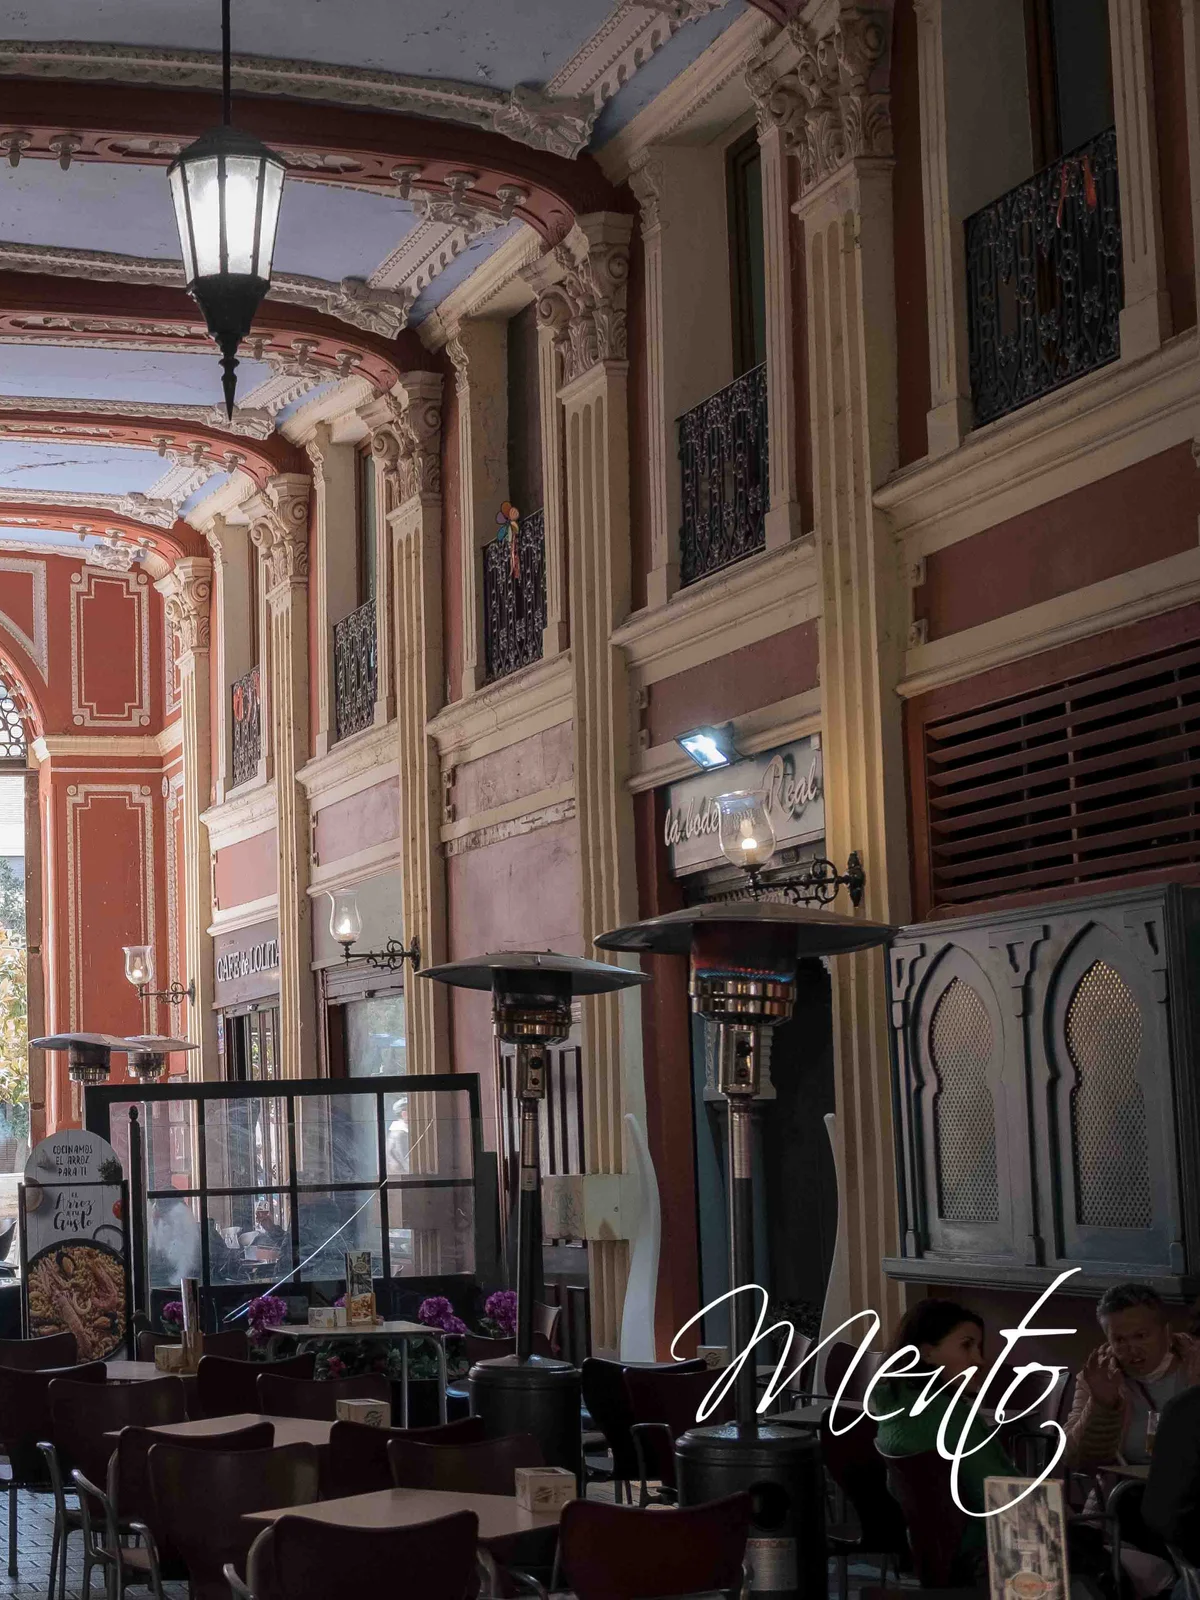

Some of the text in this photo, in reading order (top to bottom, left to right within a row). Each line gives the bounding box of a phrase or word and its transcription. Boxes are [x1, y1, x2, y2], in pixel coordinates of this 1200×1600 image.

[761, 754, 817, 823] Real
[52, 1144, 93, 1155] COCINAMOS
[56, 1155, 90, 1166] EL ARROZ
[58, 1166, 87, 1177] PARA TI
[53, 1210, 94, 1233] Gusto
